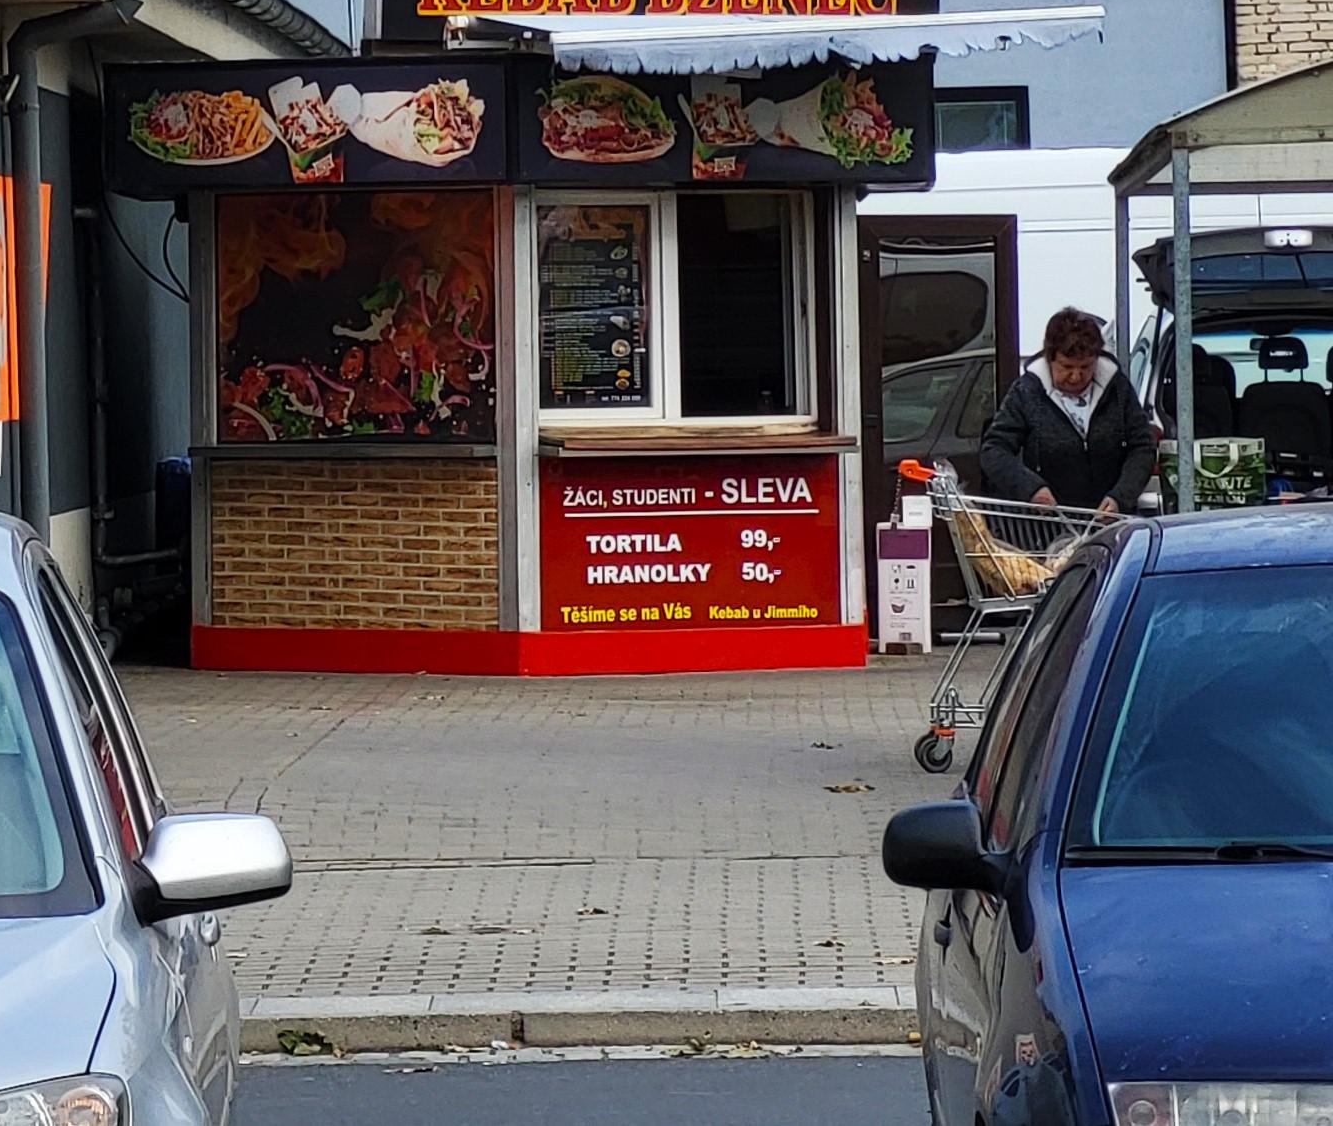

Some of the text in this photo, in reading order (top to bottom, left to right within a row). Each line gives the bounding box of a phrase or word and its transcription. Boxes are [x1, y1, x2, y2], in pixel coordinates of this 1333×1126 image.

[562, 486, 609, 509] ŽÁCI,
[611, 487, 697, 506] STUDENTI
[721, 477, 814, 504] SLEVA
[586, 529, 781, 554] TORTILA 99,-
[587, 562, 782, 584] HRANOLKY 50,-
[560, 602, 692, 624] Těšíme se na Vás
[708, 604, 818, 620] Kebab u Jimmiho
